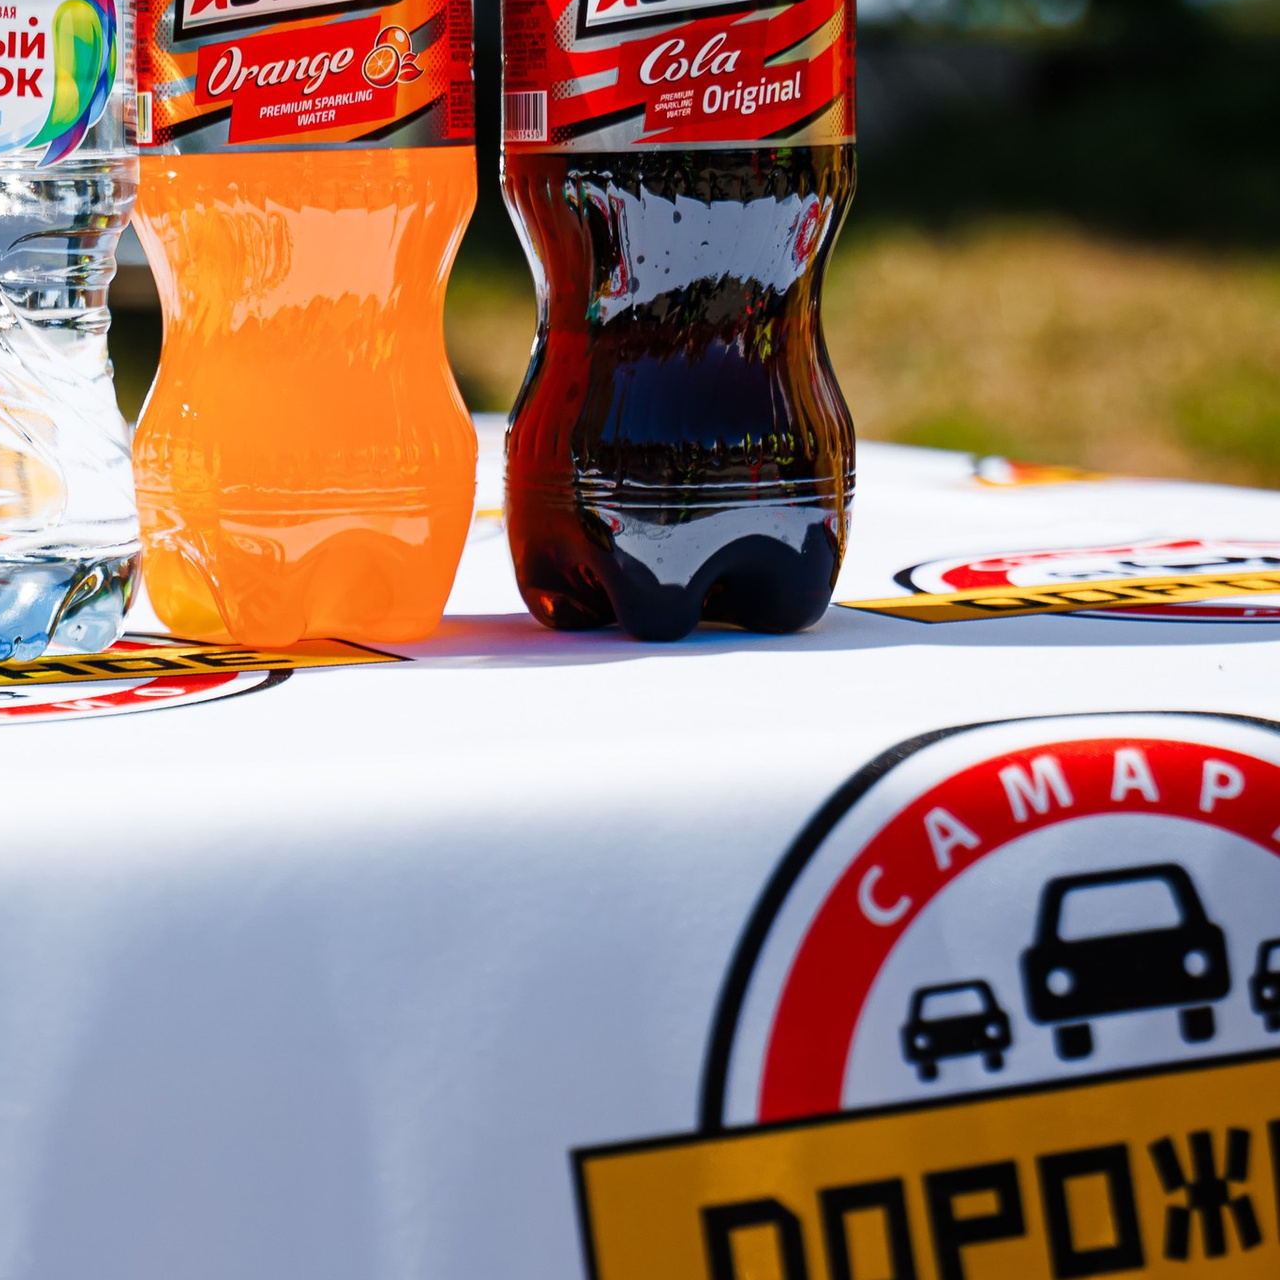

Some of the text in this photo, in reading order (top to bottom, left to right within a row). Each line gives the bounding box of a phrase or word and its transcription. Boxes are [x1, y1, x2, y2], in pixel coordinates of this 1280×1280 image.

[207, 46, 355, 96] Orange
[639, 31, 742, 86] Cola
[259, 88, 374, 120] PREMIUM SPARKLING
[654, 98, 694, 113] SPARKLING
[659, 89, 695, 102] PREMIUM
[702, 70, 801, 115] Original
[297, 108, 337, 127] WATER
[666, 107, 692, 119] WATER
[855, 747, 1280, 928] САМАР
